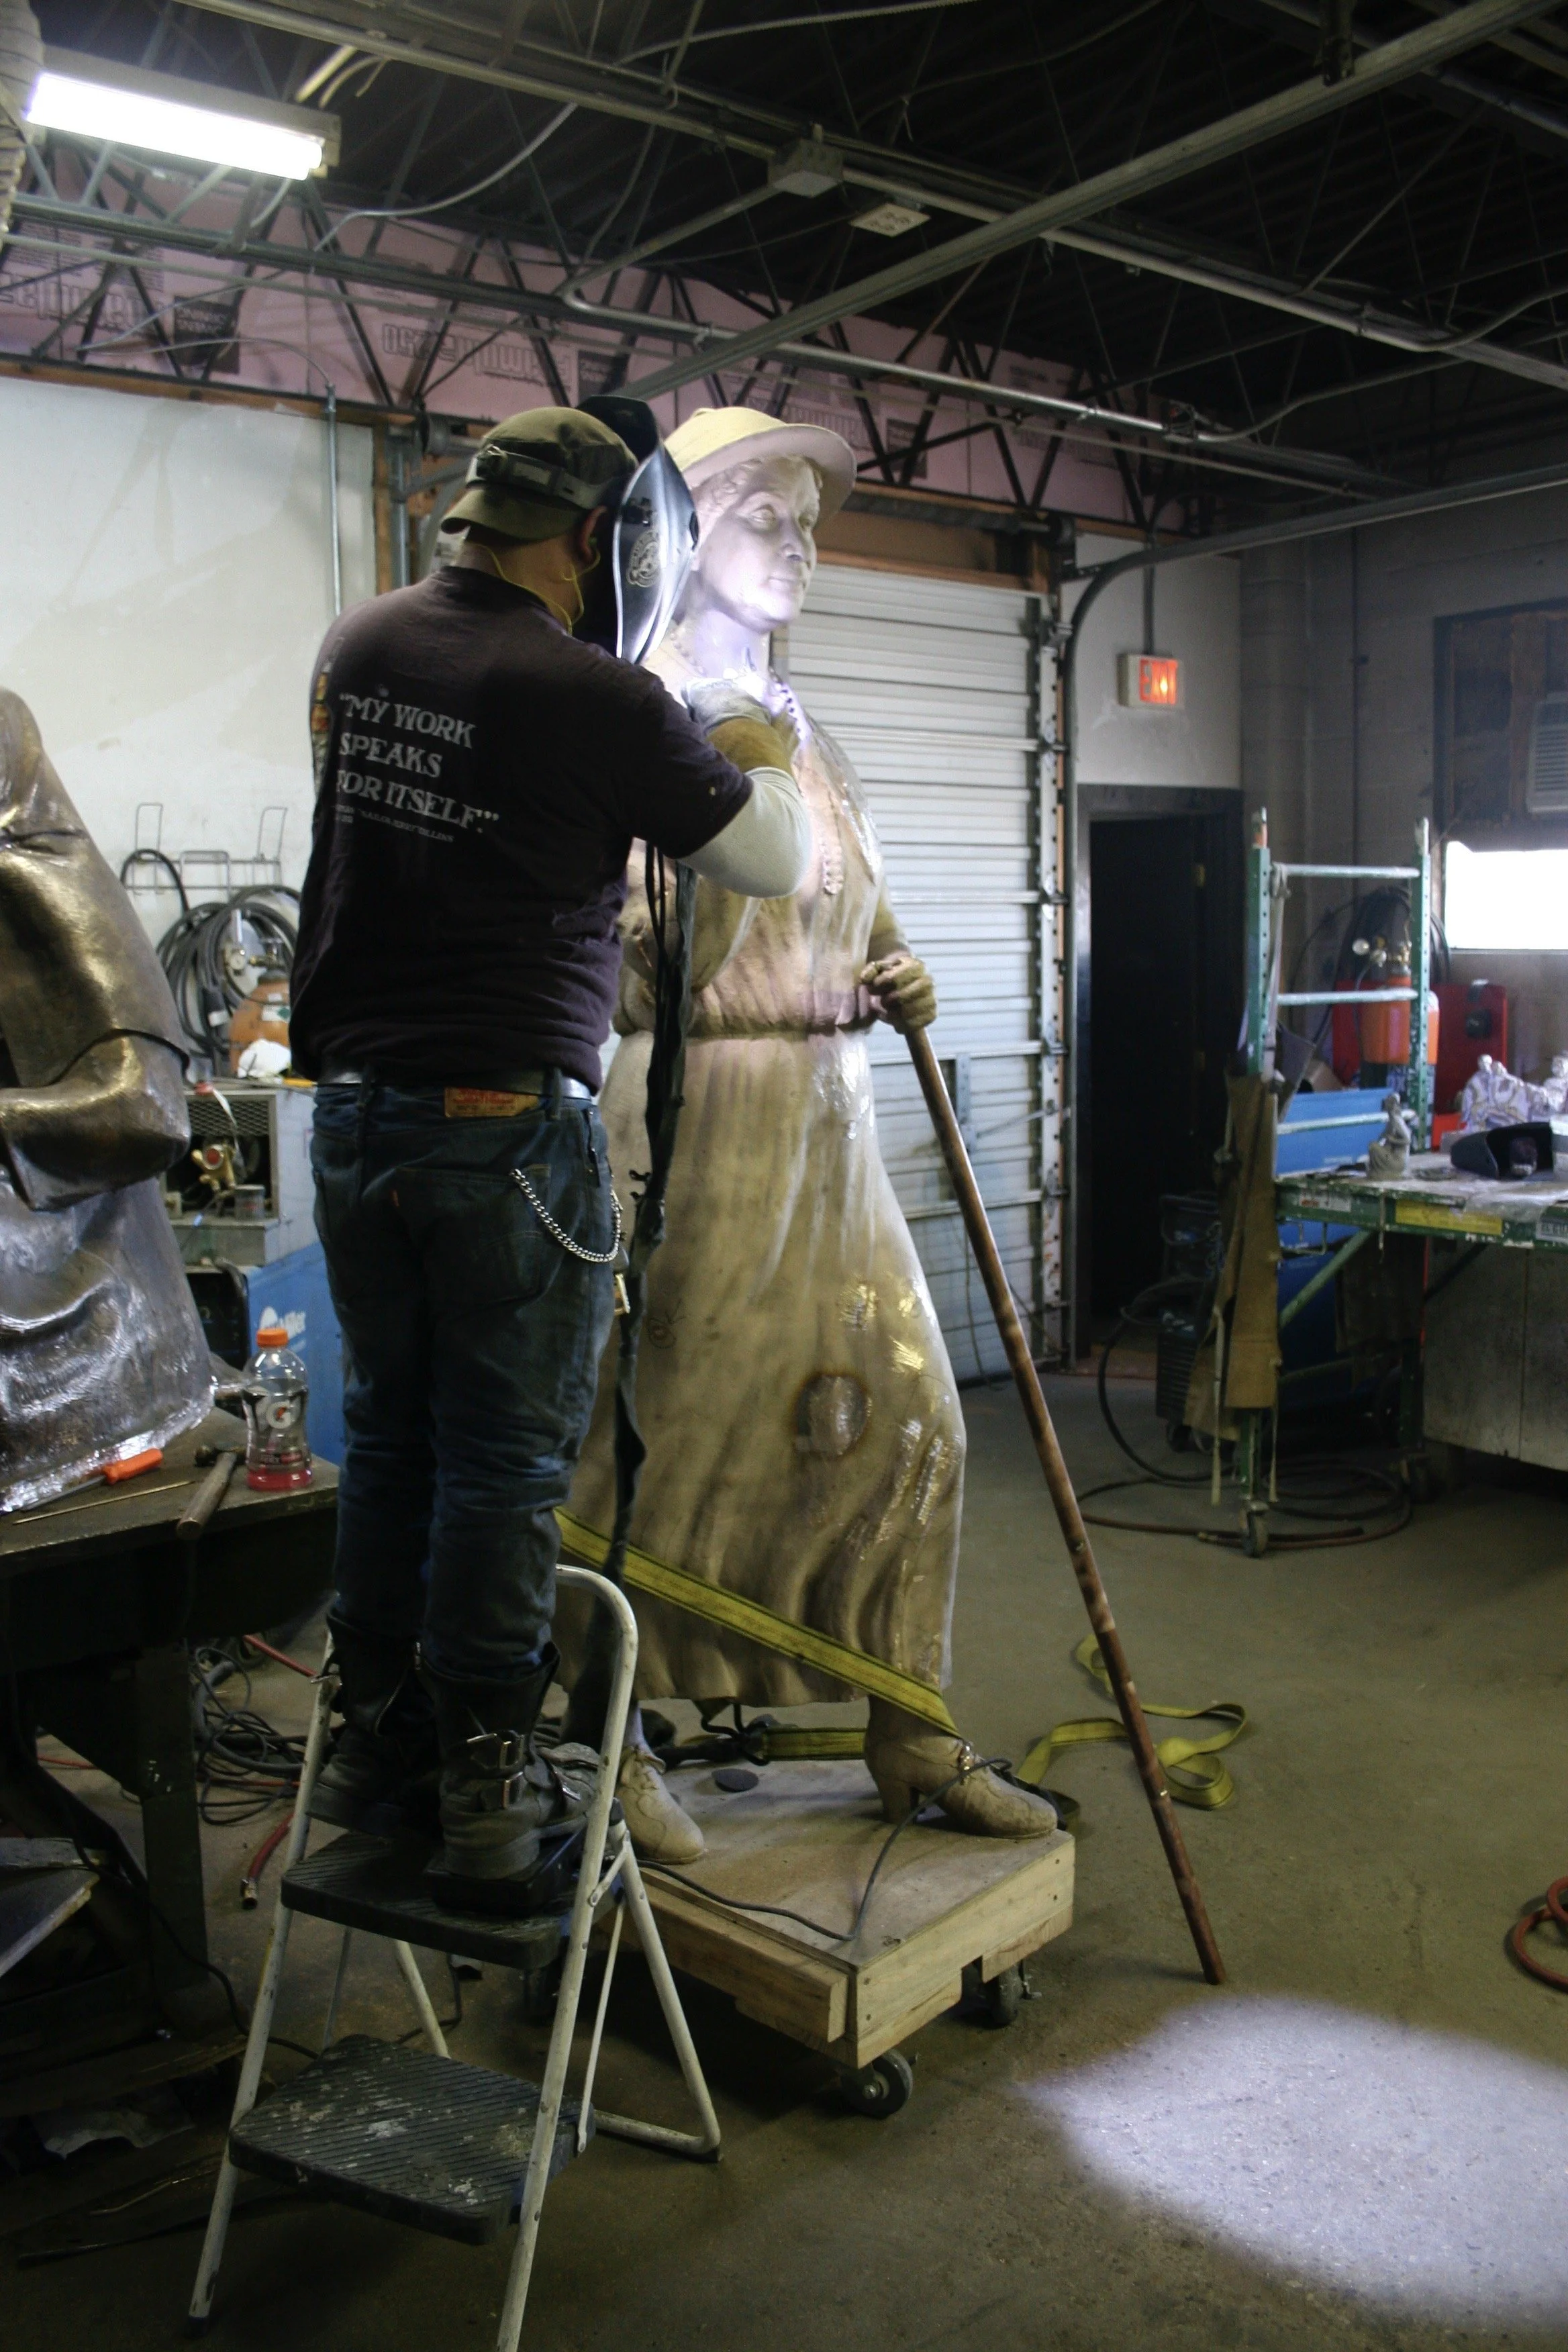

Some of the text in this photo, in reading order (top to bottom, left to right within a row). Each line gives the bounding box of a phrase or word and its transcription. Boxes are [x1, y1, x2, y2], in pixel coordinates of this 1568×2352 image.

[339, 693, 476, 750] "MY WORK
[339, 732, 443, 777] SPEAKS
